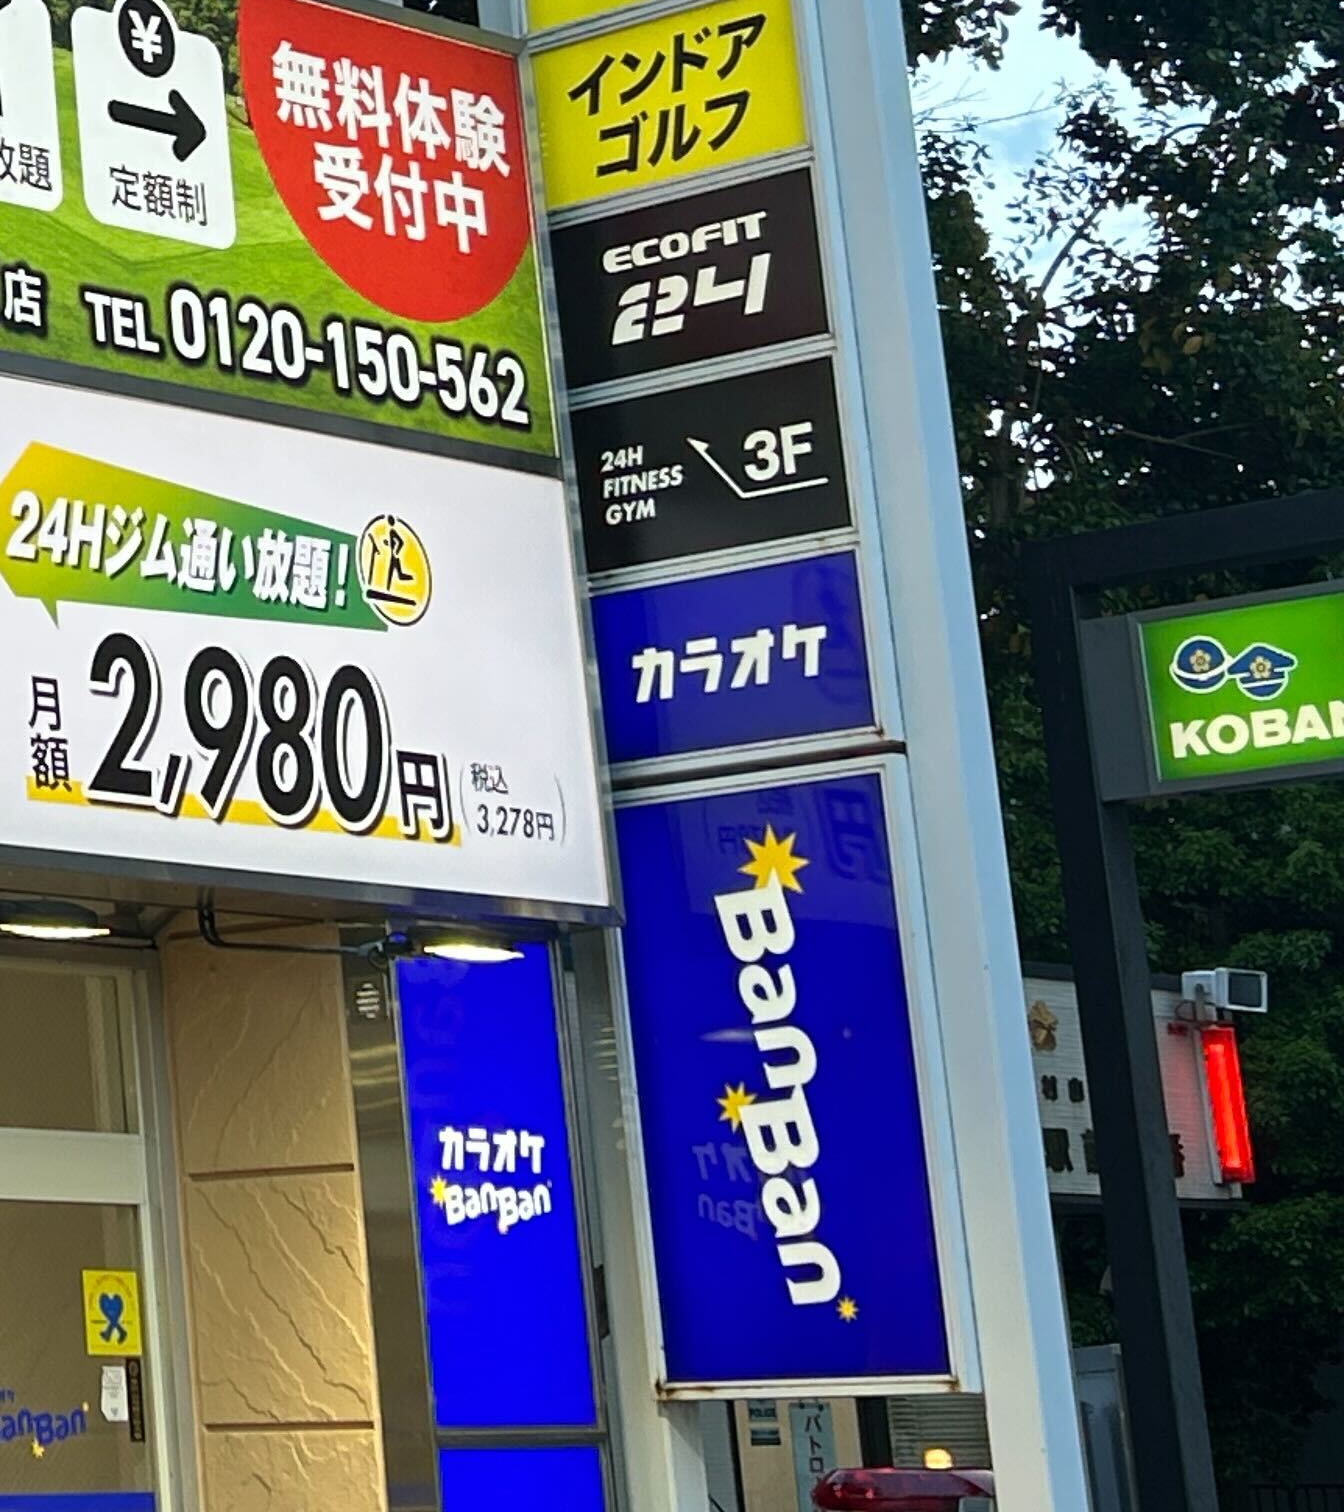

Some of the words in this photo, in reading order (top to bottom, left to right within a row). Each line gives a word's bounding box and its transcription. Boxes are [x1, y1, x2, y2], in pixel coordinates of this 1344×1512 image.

[568, 12, 768, 117] インドア
[271, 39, 511, 178] 無料体験
[596, 89, 751, 179] ゴルフ
[108, 164, 208, 227] 定額制
[312, 140, 490, 255] 受付中
[602, 210, 768, 274] ECOFIT
[612, 252, 772, 346] 24
[84, 291, 160, 355] TEL
[170, 287, 529, 426] 0120-150-562
[600, 445, 644, 474] 24H
[603, 464, 684, 499] FITNESS
[743, 420, 814, 482] 3F
[605, 497, 656, 526] GYM
[5, 489, 350, 612] 24Hジム通い放題！
[632, 622, 827, 704] カラオケ
[29, 675, 72, 794] 月額
[470, 762, 509, 795] 税込
[477, 803, 555, 842] 3,278円
[714, 869, 842, 1306] BanBan
[439, 1125, 545, 1175] カラオケ
[443, 1181, 552, 1227] BanBan
